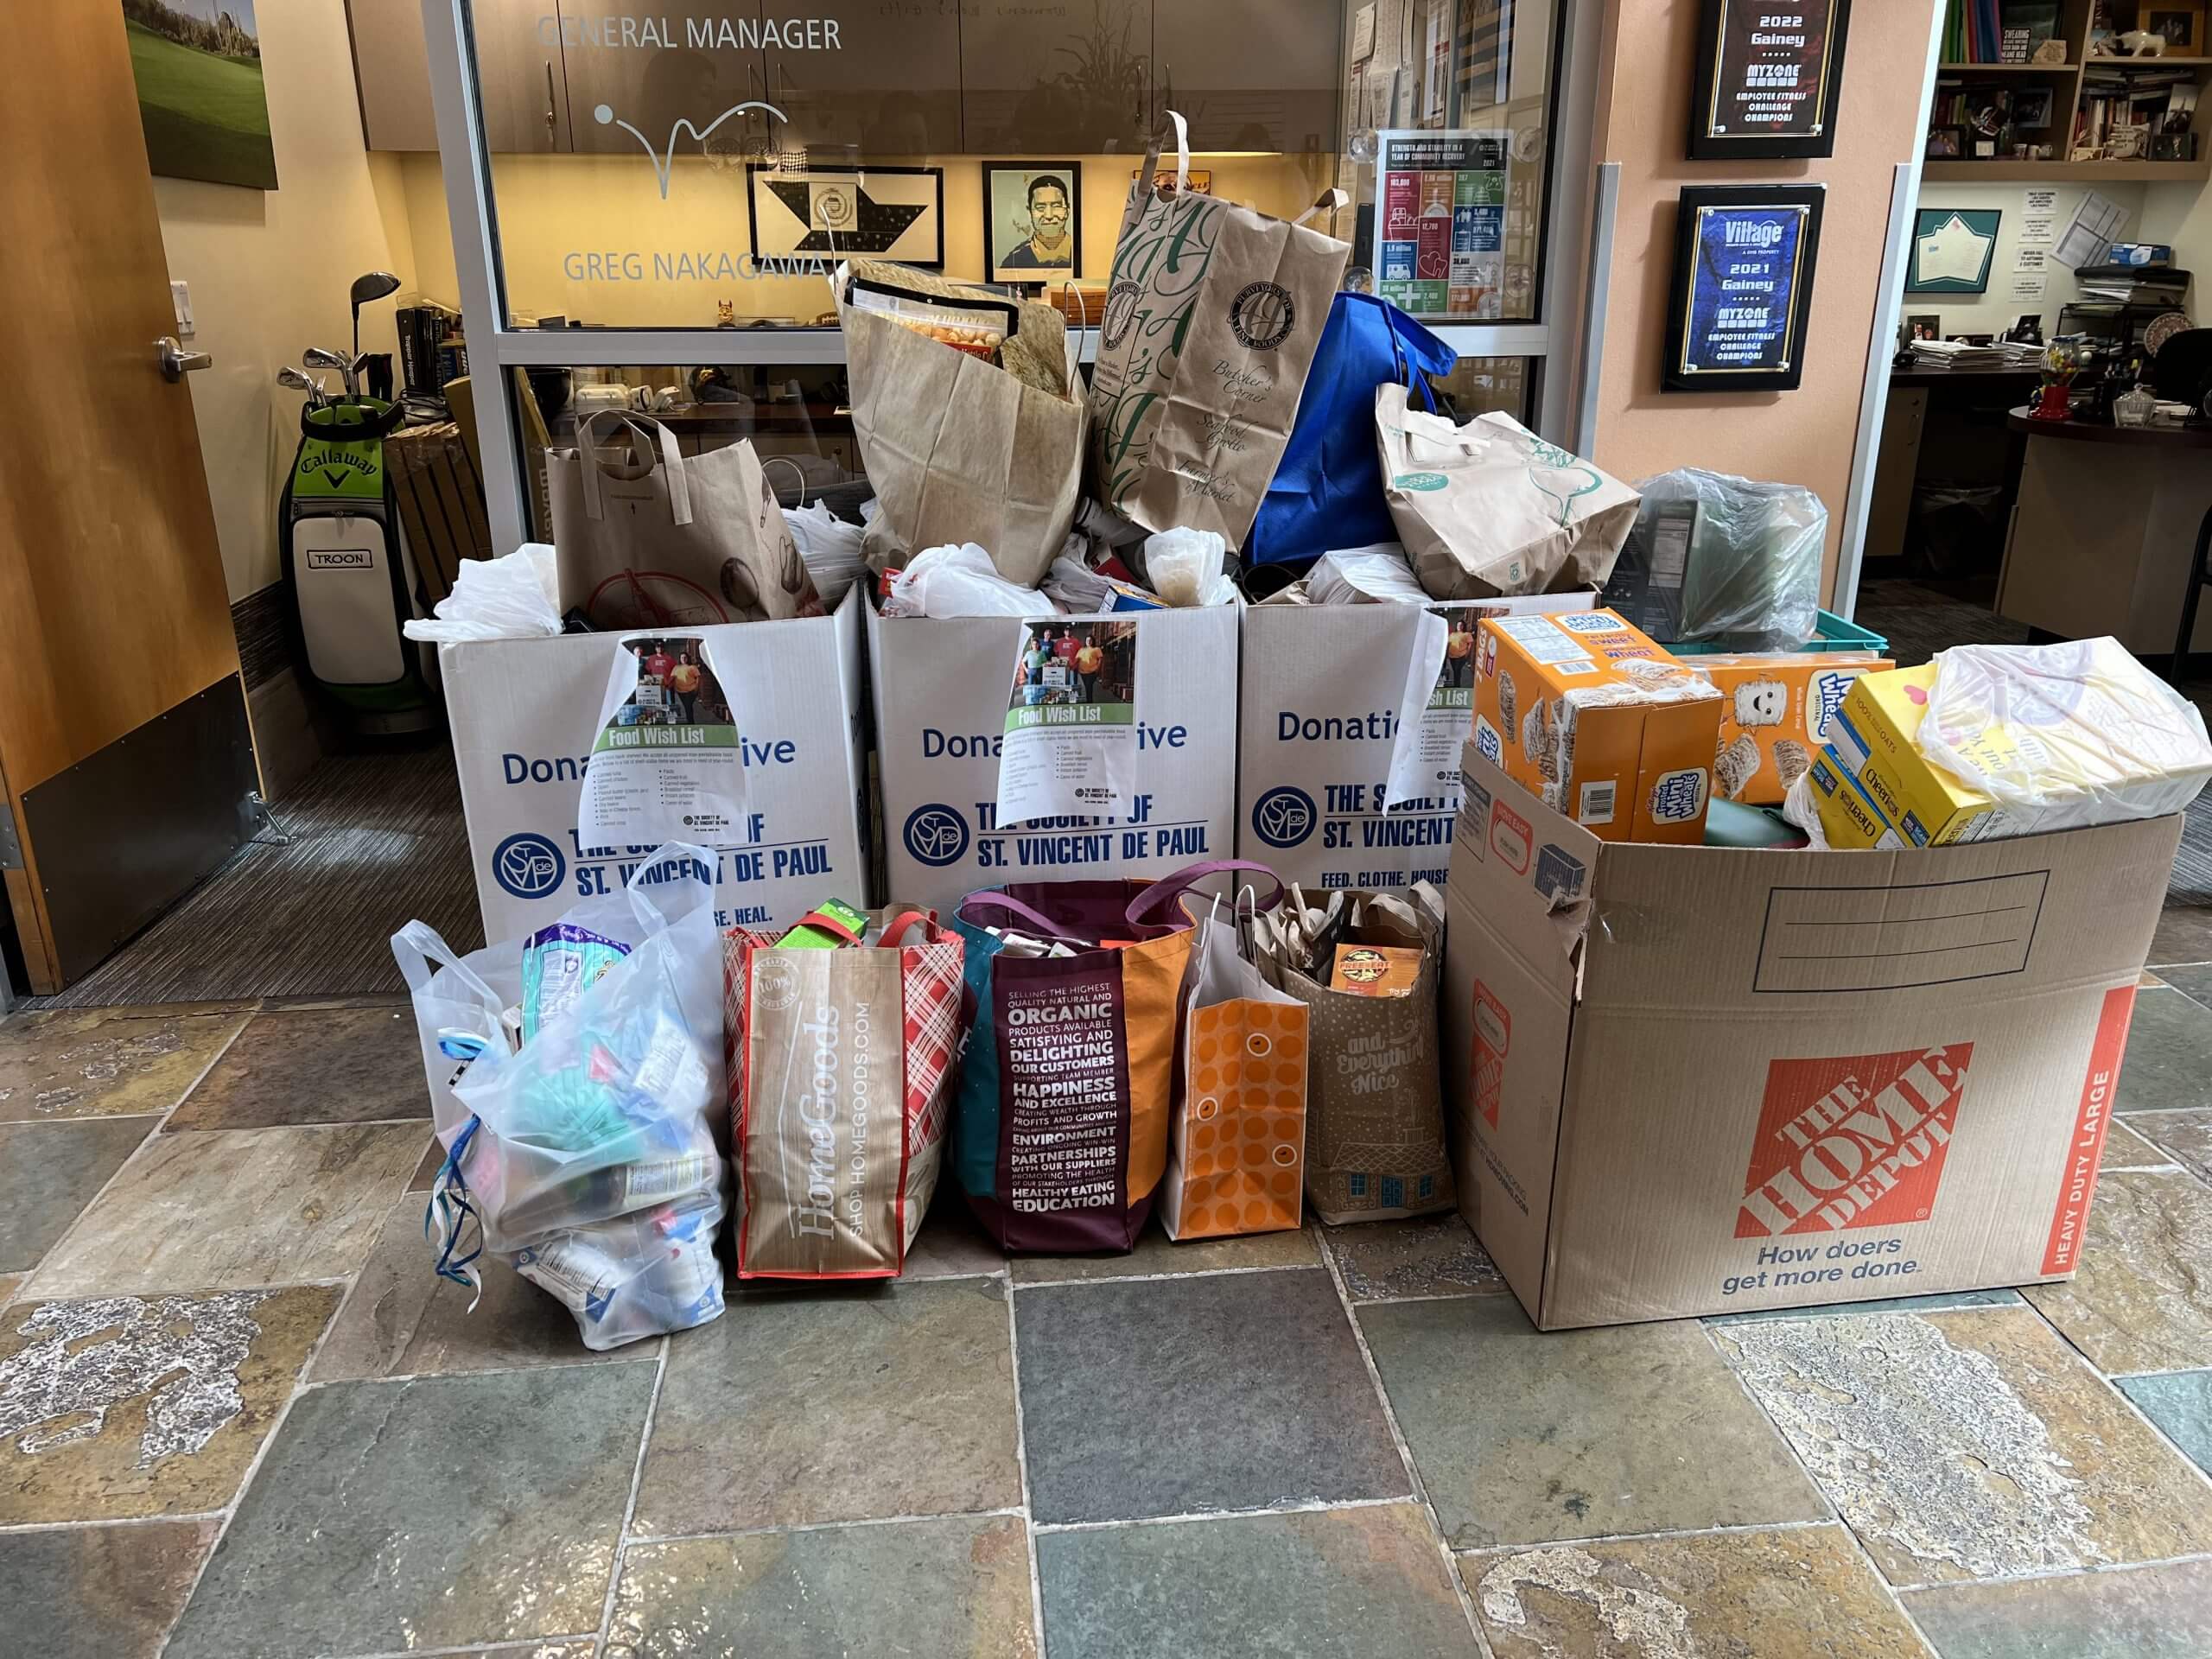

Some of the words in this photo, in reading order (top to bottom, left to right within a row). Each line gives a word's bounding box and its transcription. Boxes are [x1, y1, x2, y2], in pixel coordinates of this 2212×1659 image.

[538, 16, 677, 48] GENERAL
[686, 17, 842, 49] MANAGER
[1759, 16, 1802, 27] 2022
[1751, 33, 1804, 47] Gainey
[1747, 64, 1802, 77] MYZONE
[1744, 113, 1792, 122] CHAMPIONS
[1726, 221, 1783, 247] Village
[563, 253, 642, 281] GREG
[654, 252, 827, 280] NAKAGAWA
[1730, 264, 1769, 274] 2021
[1721, 279, 1774, 291] Gainey
[1718, 308, 1770, 319] MYZONE
[1708, 333, 1745, 341] EMPLOYEE
[1747, 332, 1775, 340] FITNESS
[1212, 359, 1273, 391] Butcher's
[1224, 380, 1267, 403] Corner
[300, 448, 378, 476] Callaway
[315, 554, 364, 564] TROON
[1478, 626, 1486, 668] BAGS
[1429, 690, 1443, 706] sh
[1446, 690, 1467, 705] List
[1019, 707, 1042, 724] Food
[1046, 706, 1076, 722] Wish
[1079, 706, 1101, 721] List
[1278, 709, 1400, 741] Donati
[609, 728, 639, 747] Food
[643, 728, 677, 745] Wish
[686, 728, 704, 744] List
[923, 728, 1002, 758] Dona
[1137, 721, 1186, 749] ive
[1879, 730, 1897, 753] OATS
[502, 753, 588, 784] Dona
[741, 737, 796, 766] ive
[1325, 785, 1365, 812] THE
[1657, 785, 1669, 813] Frosted
[1666, 778, 1685, 817] Mini
[1680, 773, 1699, 818] Wheats
[1866, 768, 1899, 817] Cheerios
[1839, 790, 1876, 836] Cheerios
[1324, 822, 1352, 848] ST.
[1363, 817, 1454, 847] VINCENT
[978, 838, 1007, 866] ST.
[1017, 834, 1113, 863] VINCENT
[1123, 831, 1147, 858] DE
[1157, 827, 1209, 855] PAUL
[576, 866, 610, 896] ST.
[736, 854, 764, 881] DE
[773, 845, 832, 877] PAUL
[1321, 872, 1353, 887] FEED.
[1358, 871, 1406, 887] CLOTHE.
[735, 906, 772, 925] HEAL.
[760, 976, 791, 992] 100%
[1008, 990, 1046, 1000] SELLING
[1070, 982, 1110, 994] HIGHEST
[1007, 999, 1046, 1008] QUALITY
[1050, 995, 1090, 1004] NATURAL
[1092, 993, 1111, 1001] AND
[1007, 1002, 1112, 1025] ORGANIC
[1008, 1025, 1060, 1036] PRODUCTS
[1064, 1020, 1111, 1032] AVAILABLE
[1009, 1033, 1082, 1048] SATISFYING
[1086, 1030, 1113, 1041] AND
[1010, 1041, 1113, 1062] DELIGHTING
[1348, 1032, 1385, 1053] and
[1011, 1064, 1038, 1073] OUR
[1039, 1055, 1114, 1072] CUSTOMERS
[1061, 1071, 1080, 1079] TEAM
[1084, 1068, 1113, 1077] MEMBER
[851, 1001, 870, 1185] HOMEGOODS.COM
[1013, 1076, 1115, 1097] HAPPINESS
[1351, 1071, 1399, 1095] Nice
[1014, 1098, 1038, 1109] AND
[1041, 1091, 1116, 1108] EXCELLENCE
[797, 1006, 839, 1239] HomeGoods
[1014, 1117, 1049, 1126] PROFITS
[1075, 1110, 1116, 1122] GROWTH
[1776, 1074, 1870, 1150] THE
[1013, 1126, 1116, 1145] ENVIRONMENT
[1743, 1046, 1967, 1236] HOME
[1011, 1147, 1116, 1165] PARTNERSHIPS
[1041, 1162, 1062, 1171] OUR
[1065, 1158, 1116, 1169] SUPPLIERS
[1817, 1112, 1951, 1230] DEPOT
[2055, 1211, 2078, 1265] HEAVY
[2069, 1152, 2088, 1204] DUTY
[2079, 1071, 2109, 1147] LARGE
[1013, 1187, 1068, 1198] HEALTHY
[1071, 1180, 1115, 1196] EATING
[1013, 1192, 1115, 1211] EDUCATION
[849, 1188, 865, 1238] SHOP
[1758, 1245, 1818, 1266] How
[1826, 1236, 1901, 1259] doers
[1722, 1273, 1768, 1295] get
[1774, 1266, 1842, 1287] more
[1851, 1257, 1916, 1279] done.
